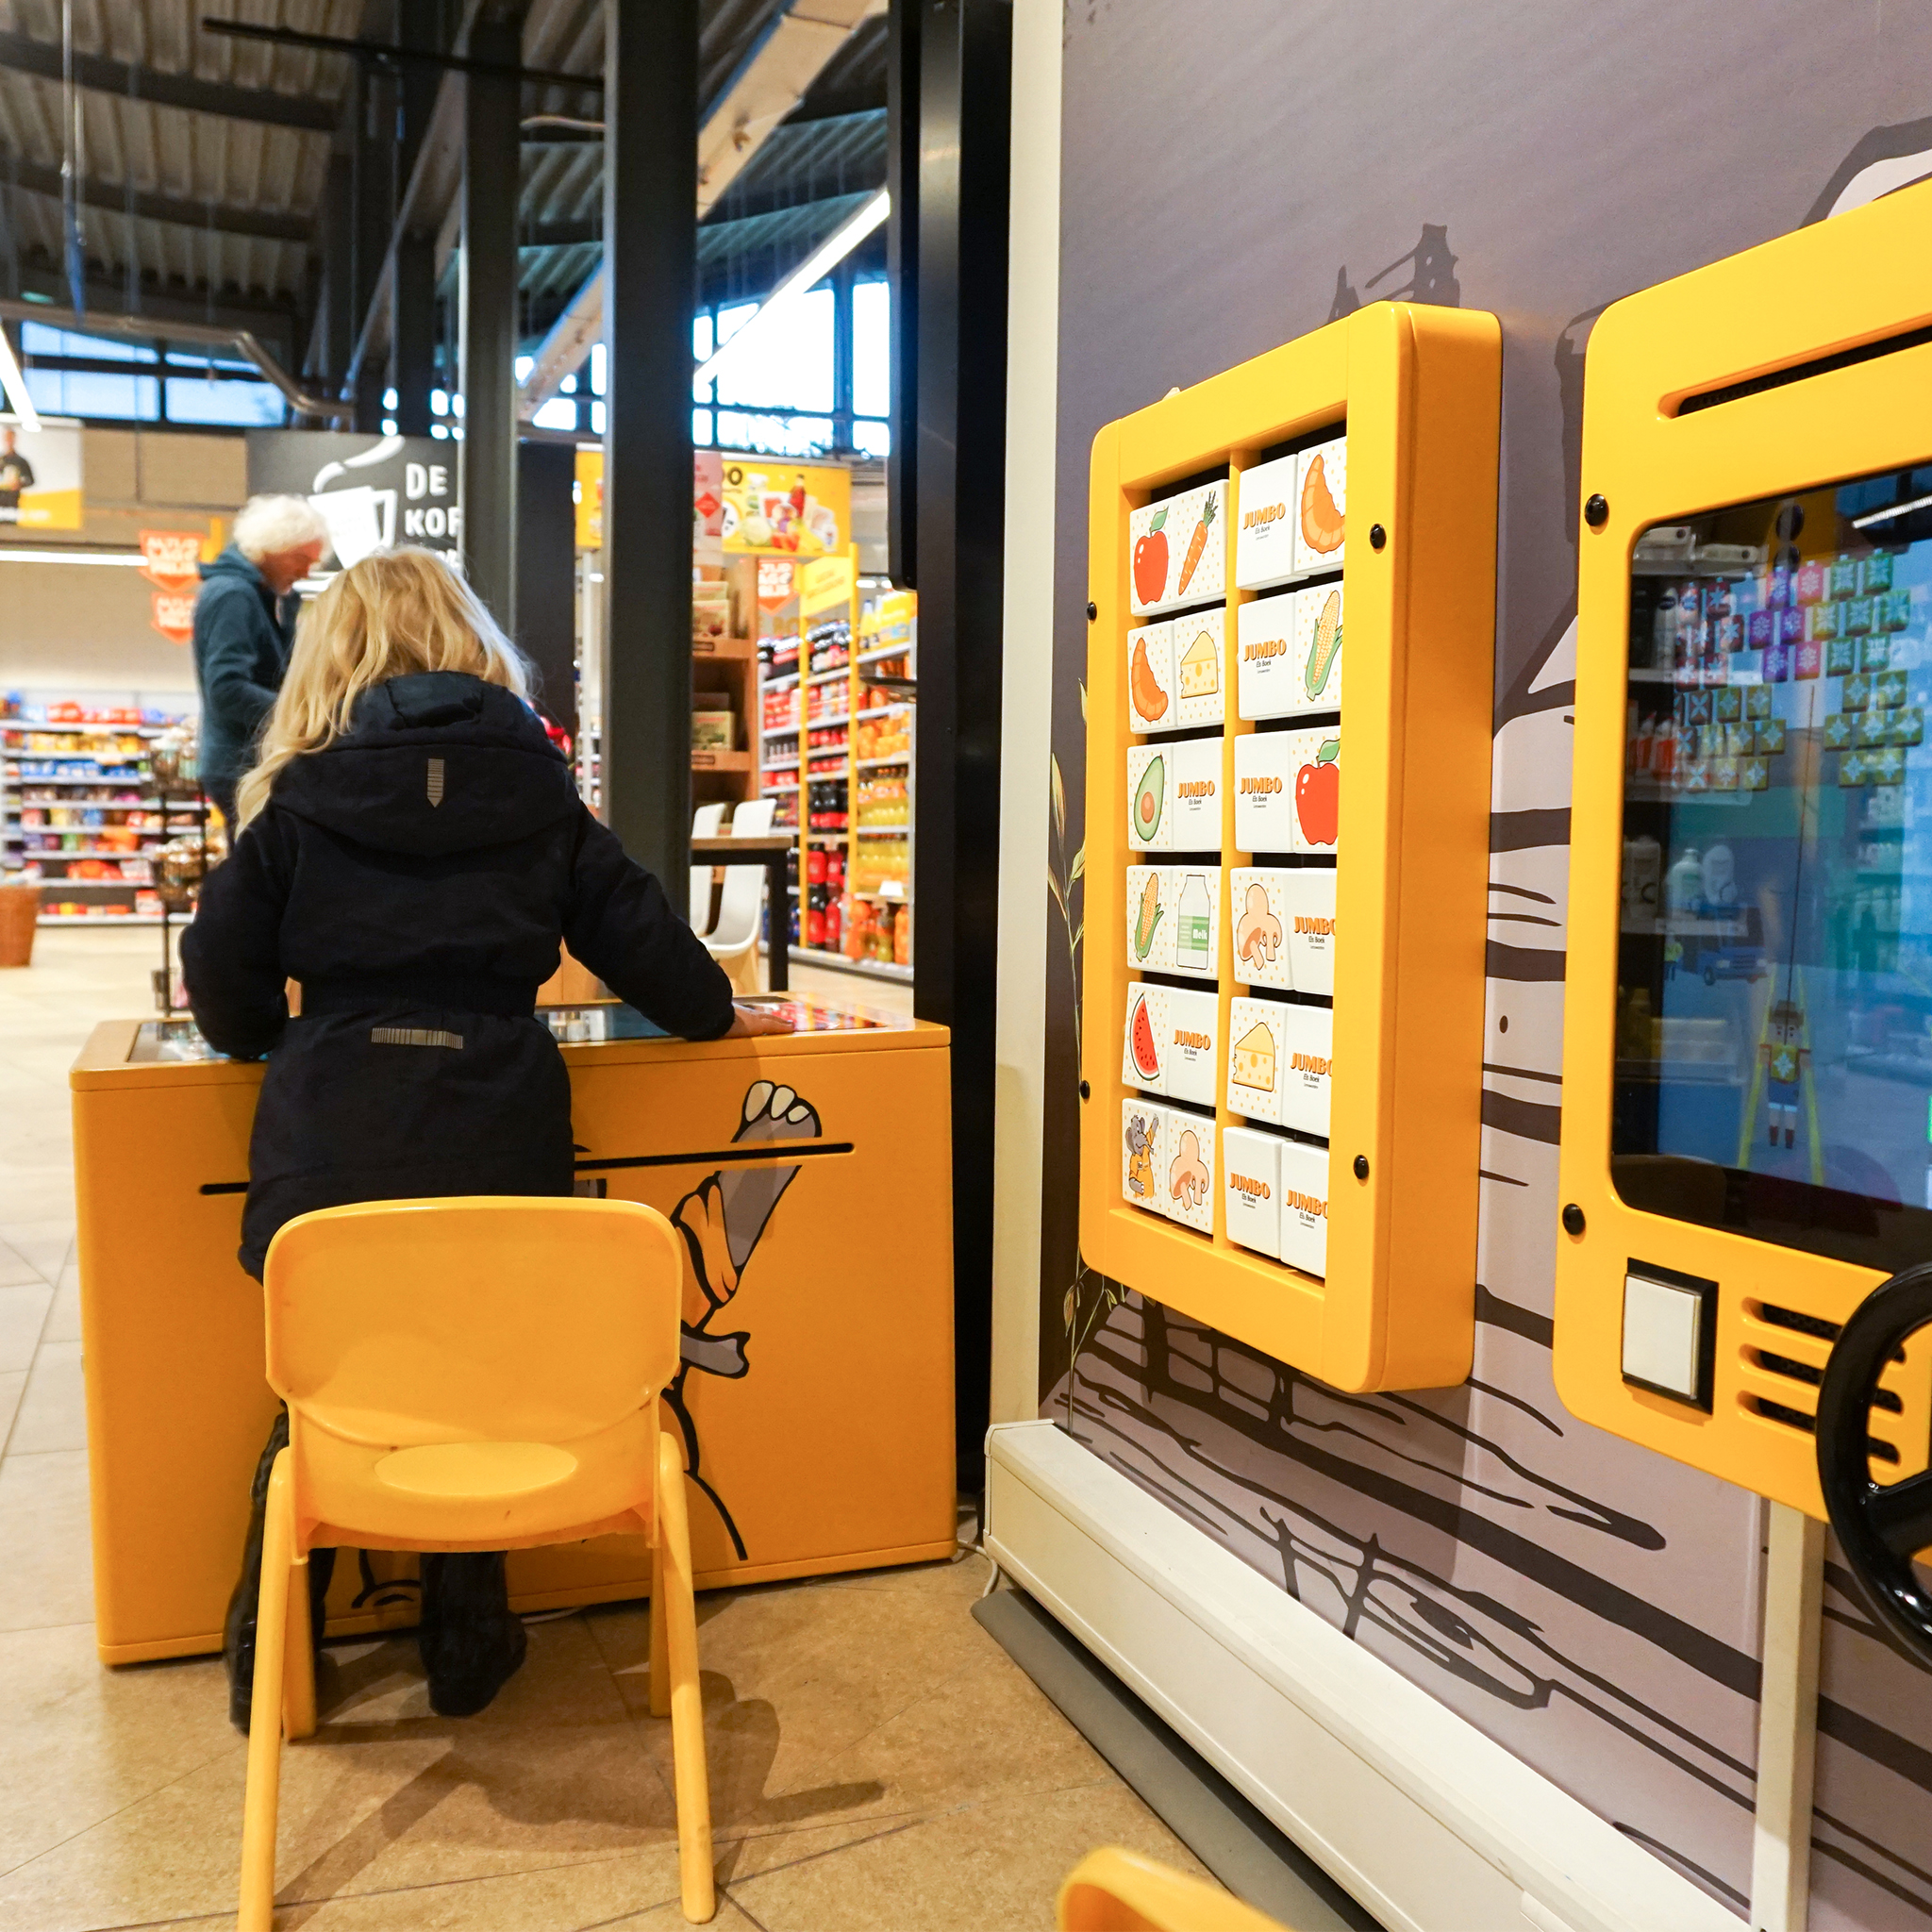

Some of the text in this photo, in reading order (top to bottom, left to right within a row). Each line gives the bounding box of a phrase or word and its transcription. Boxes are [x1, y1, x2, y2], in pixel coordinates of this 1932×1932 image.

[405, 462, 448, 500] DE
[1243, 502, 1286, 529] JUMBO
[1243, 638, 1287, 662] JUMBO
[1177, 780, 1215, 798] JUMBO
[1240, 776, 1283, 794] JUMBO
[1192, 929, 1208, 940] Melk
[1174, 1029, 1211, 1050] JUMBO
[1229, 1173, 1271, 1200] JUMBO
